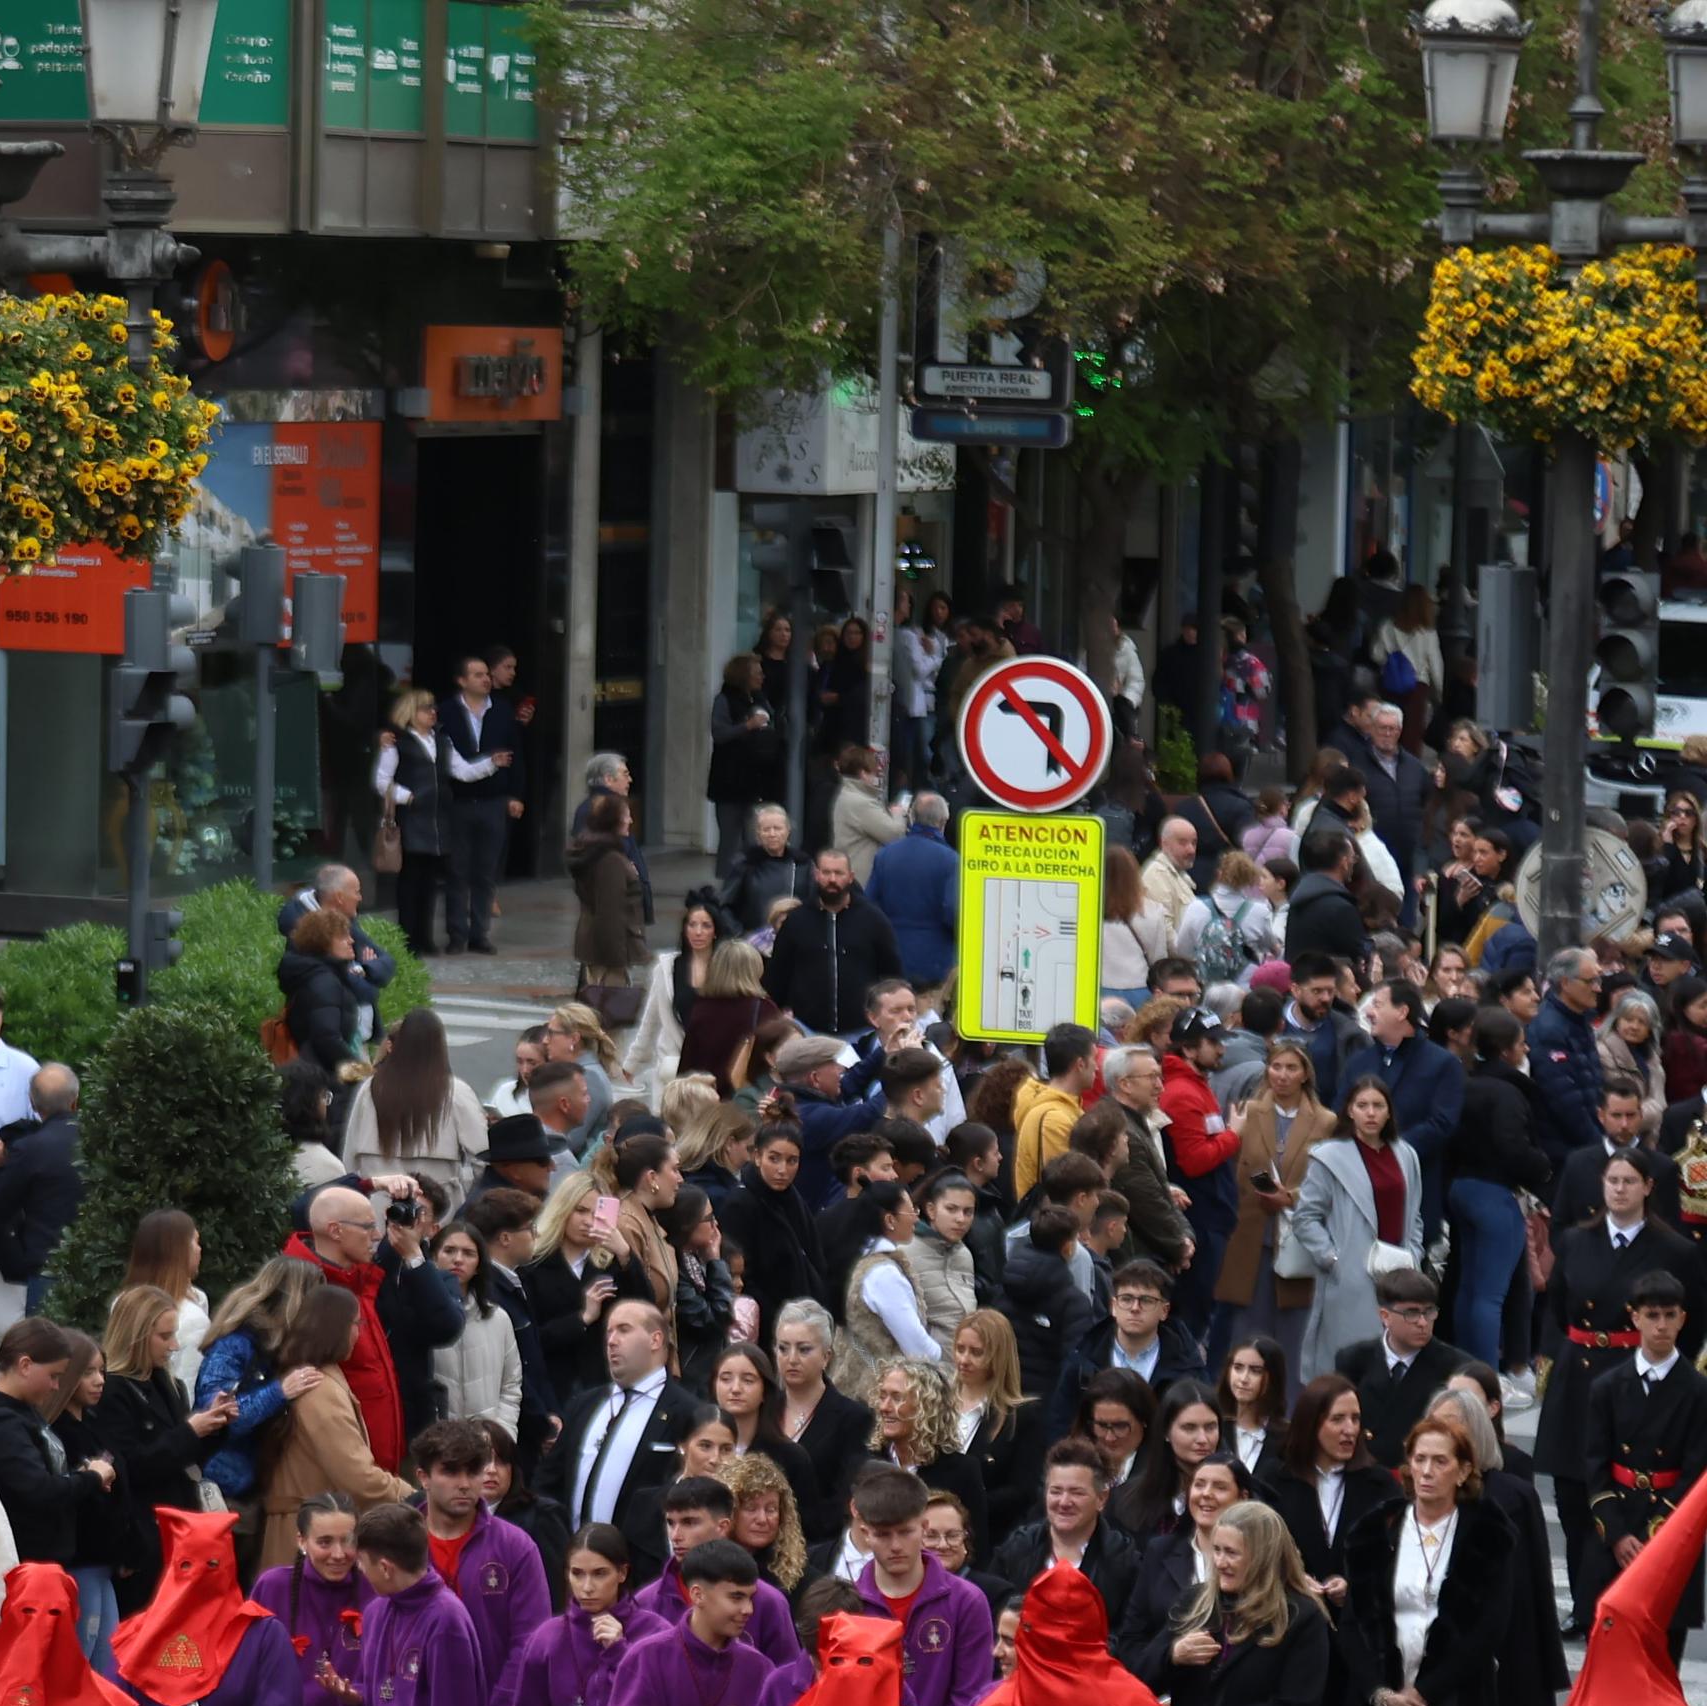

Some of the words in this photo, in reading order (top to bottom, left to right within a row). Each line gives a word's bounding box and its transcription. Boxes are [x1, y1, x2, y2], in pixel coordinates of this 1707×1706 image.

[942, 370, 995, 383] PUERTA
[1000, 373, 1034, 385] REAL
[998, 387, 1031, 396] HORAS
[6, 610, 30, 622] 958
[35, 611, 59, 623] 536
[64, 613, 88, 625] 190
[979, 824, 1088, 845] ATENCIÓN
[984, 844, 1080, 861] PRECAUCIÓN
[967, 859, 999, 872] GIRO
[1003, 861, 1012, 872] A
[1015, 862, 1032, 873] LA
[1035, 863, 1096, 878] DERECHA
[1018, 1020, 1032, 1029] BUS
